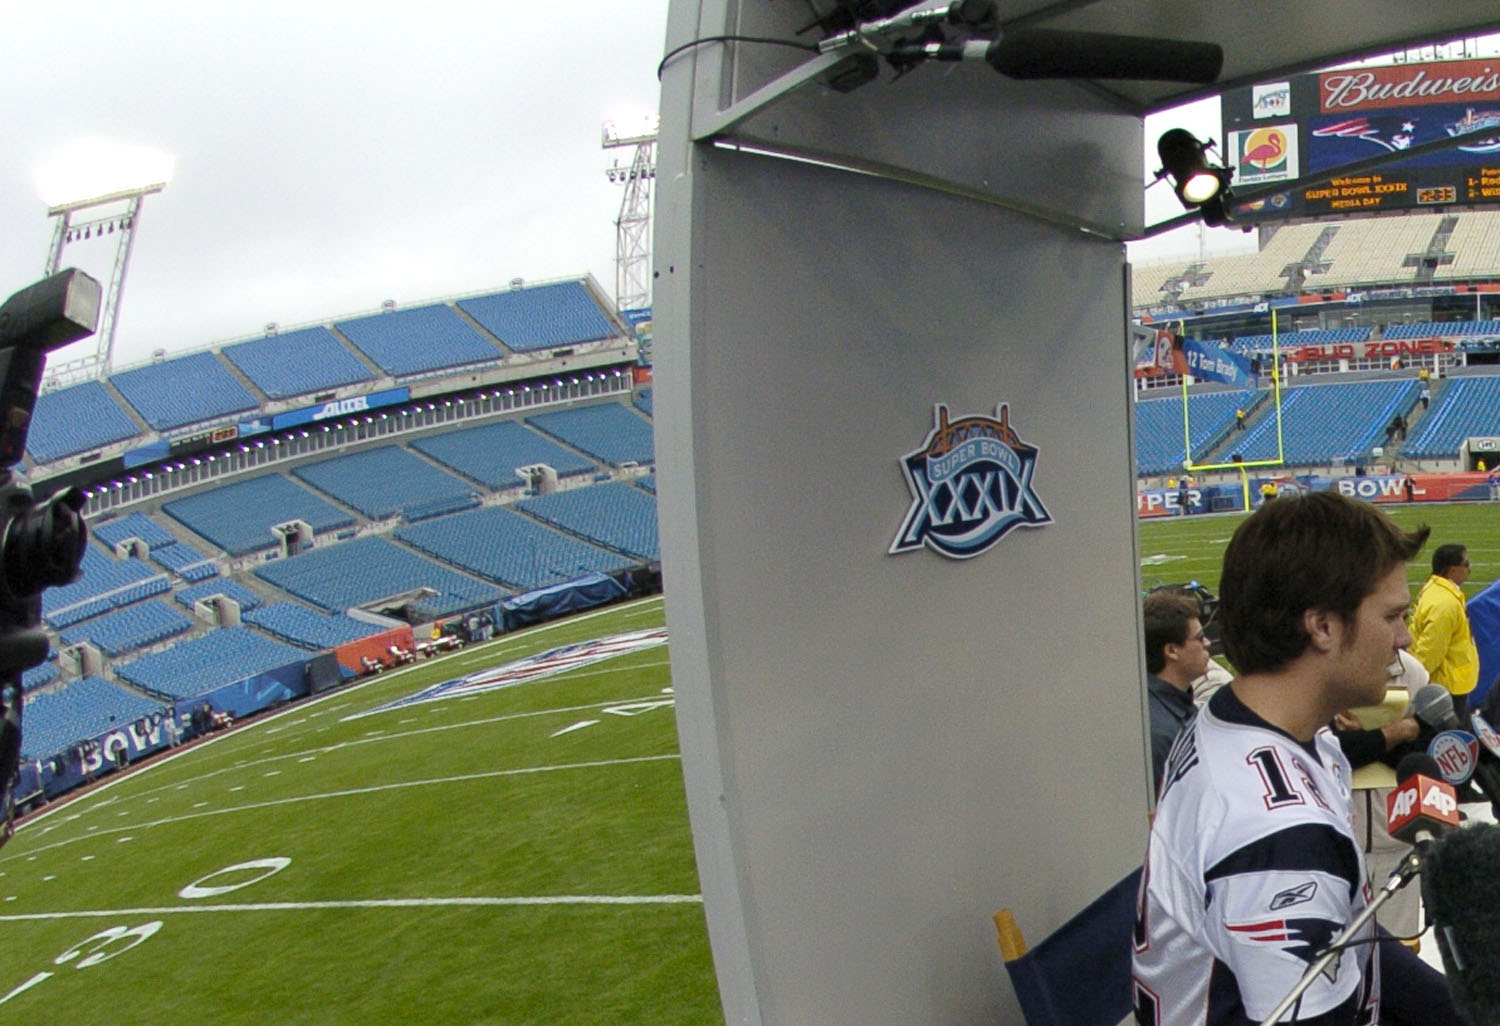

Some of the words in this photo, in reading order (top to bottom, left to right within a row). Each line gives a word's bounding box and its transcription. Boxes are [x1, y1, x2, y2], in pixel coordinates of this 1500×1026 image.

[1342, 186, 1371, 196] BOWL
[1363, 197, 1382, 206] DAY
[1308, 344, 1354, 359] BUD
[1364, 339, 1434, 358] ZONE
[1187, 350, 1198, 368] 12
[1199, 353, 1215, 372] Tom
[1216, 358, 1239, 382] Brady
[934, 443, 976, 478] SUPER
[980, 442, 1016, 470] BOWL
[905, 458, 1046, 543] XXXIX
[1436, 744, 1469, 777] NFL
[1389, 787, 1418, 824] AP
[1422, 785, 1458, 817] AP
